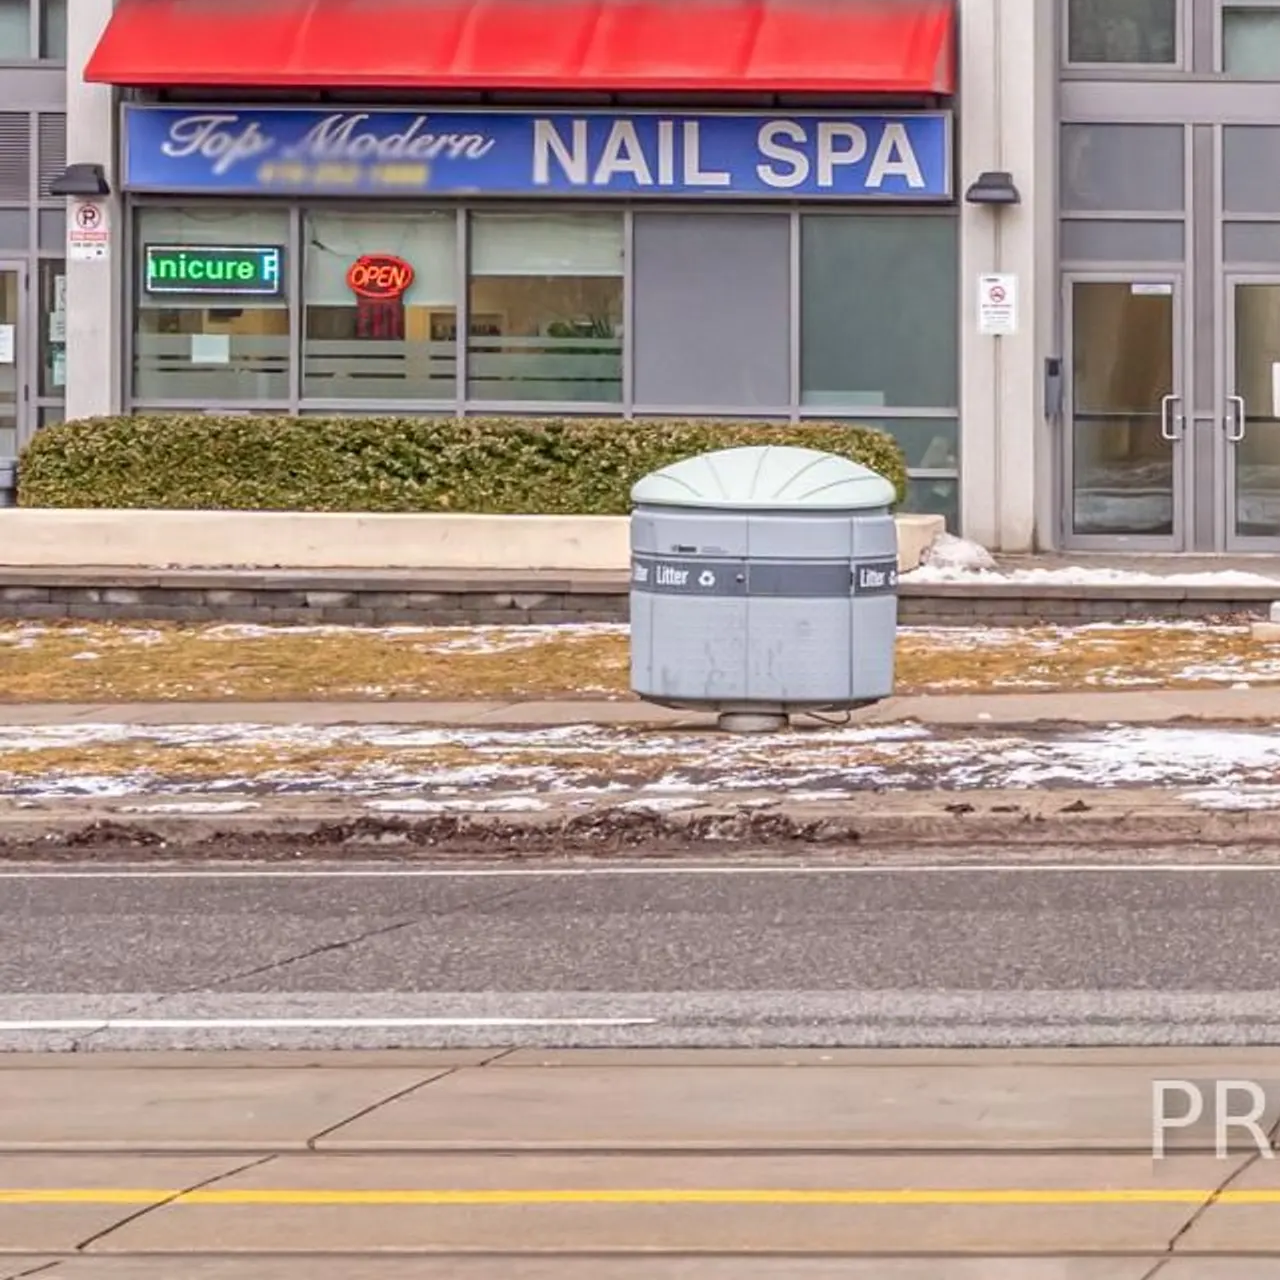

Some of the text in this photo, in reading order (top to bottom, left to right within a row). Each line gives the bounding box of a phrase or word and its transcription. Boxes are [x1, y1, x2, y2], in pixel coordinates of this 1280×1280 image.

[160, 114, 926, 189] Top Modern NAIL SPA
[351, 265, 406, 288] OPEN
[656, 565, 689, 585] Litter
